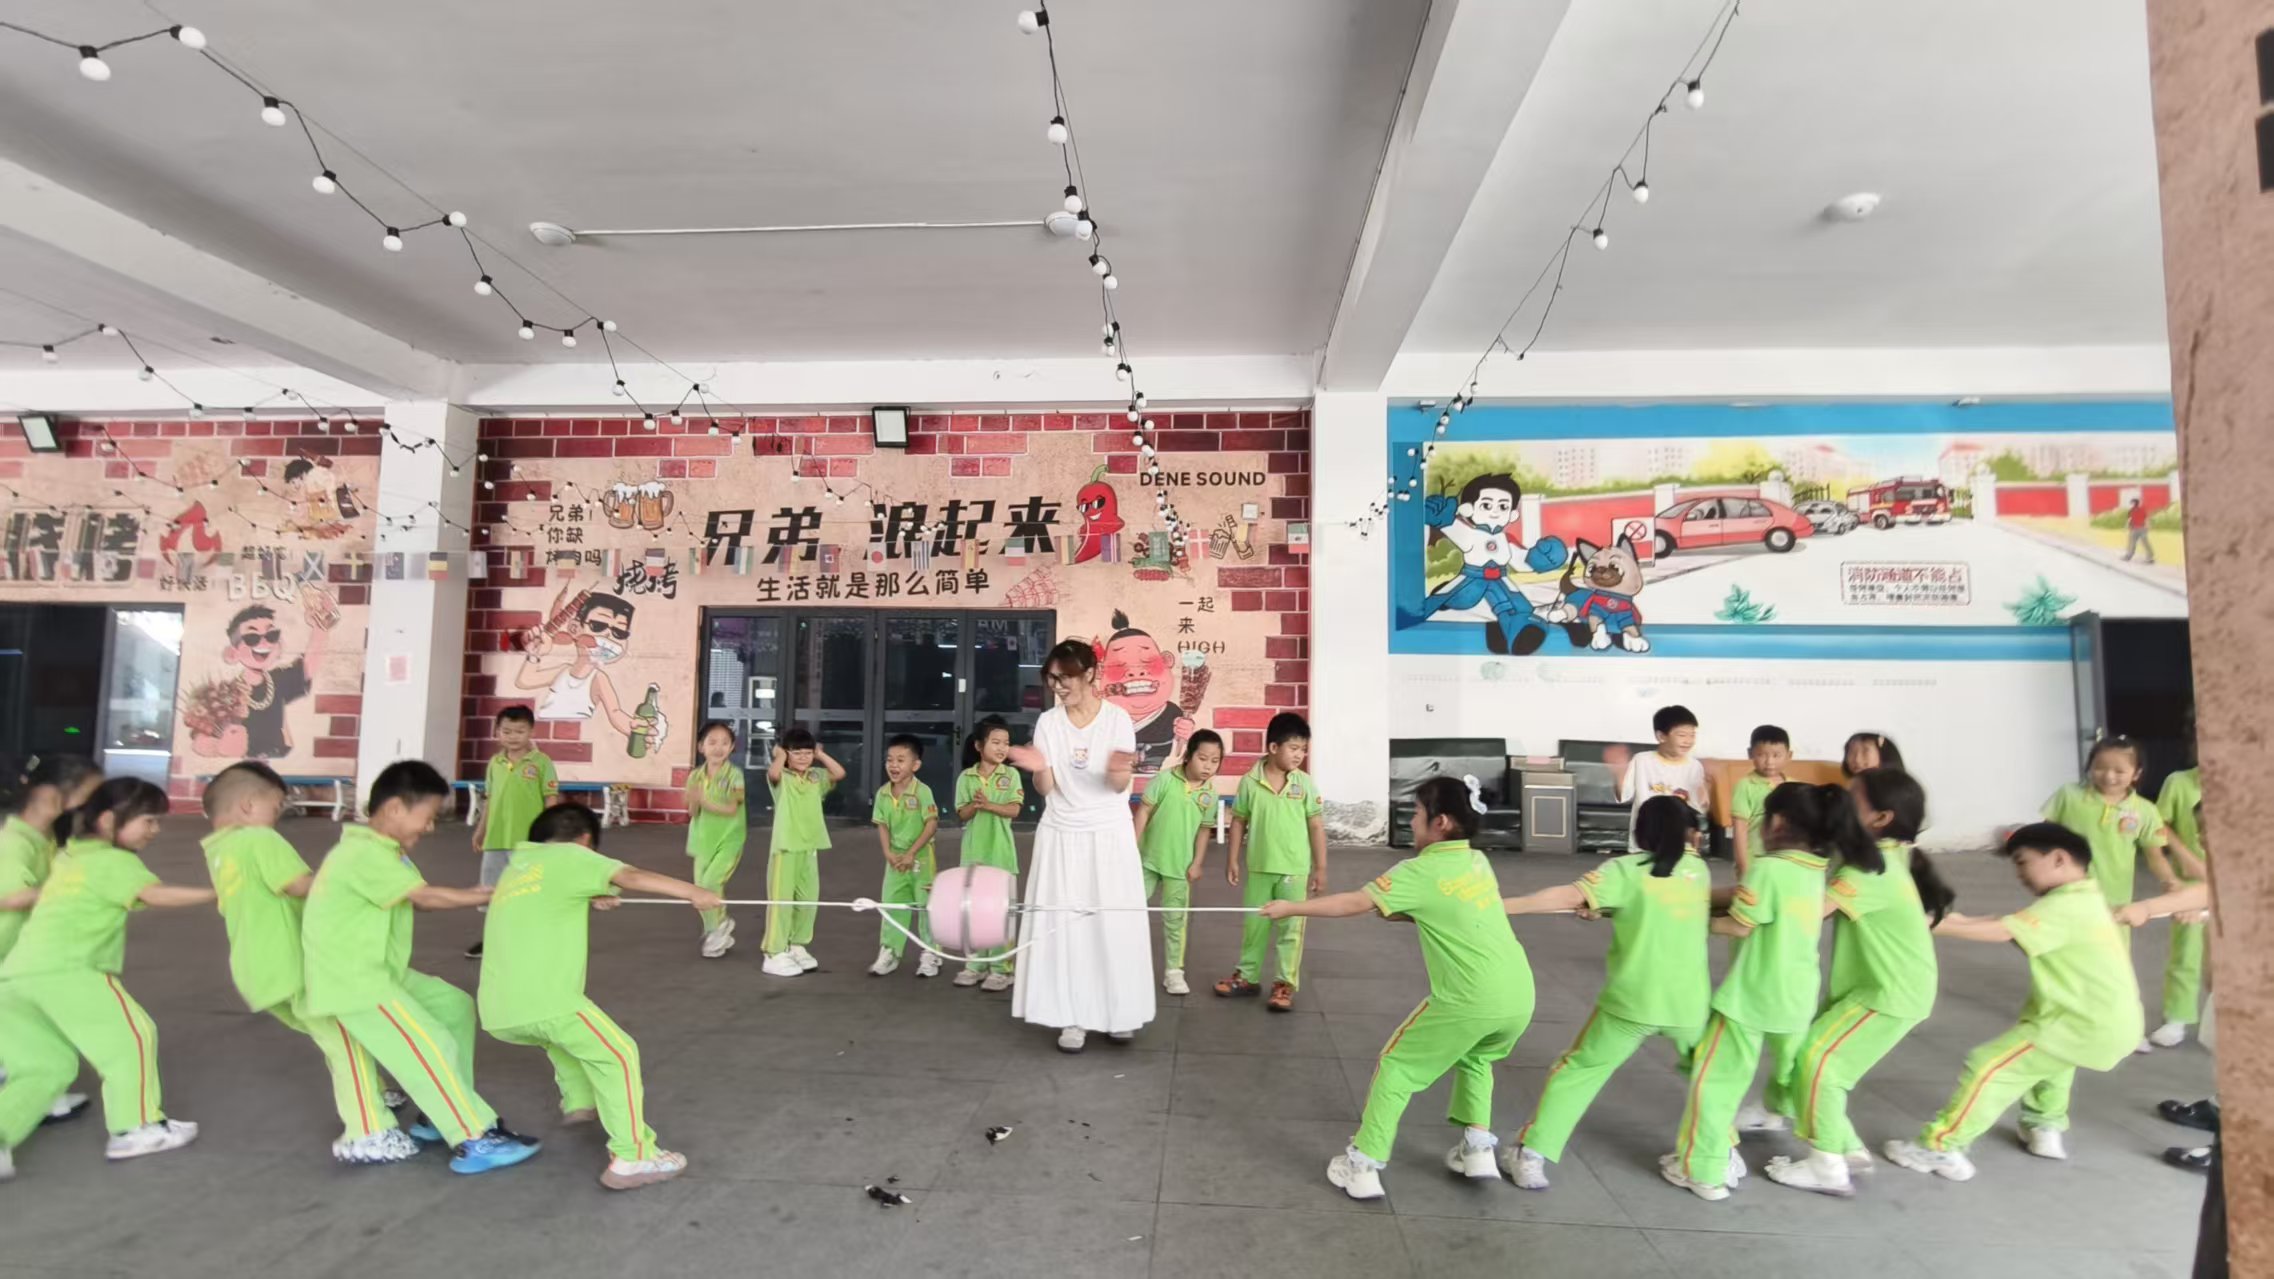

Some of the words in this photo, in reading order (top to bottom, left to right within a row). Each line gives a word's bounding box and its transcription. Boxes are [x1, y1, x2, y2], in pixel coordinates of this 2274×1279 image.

[1140, 471, 1191, 487] DENE
[1196, 471, 1266, 487] SOUND
[547, 527, 583, 544] 你缺
[705, 505, 824, 565] 兄弟
[863, 496, 1062, 562] 浪起来
[612, 556, 679, 600] 烧烤
[1848, 567, 1962, 582] 消防通道不能占
[227, 573, 296, 604] BBQ
[757, 568, 990, 602] 生活就是那么简单
[1178, 596, 1215, 613] 一起
[1178, 616, 1195, 634] 来
[1177, 640, 1225, 655] HIGH
